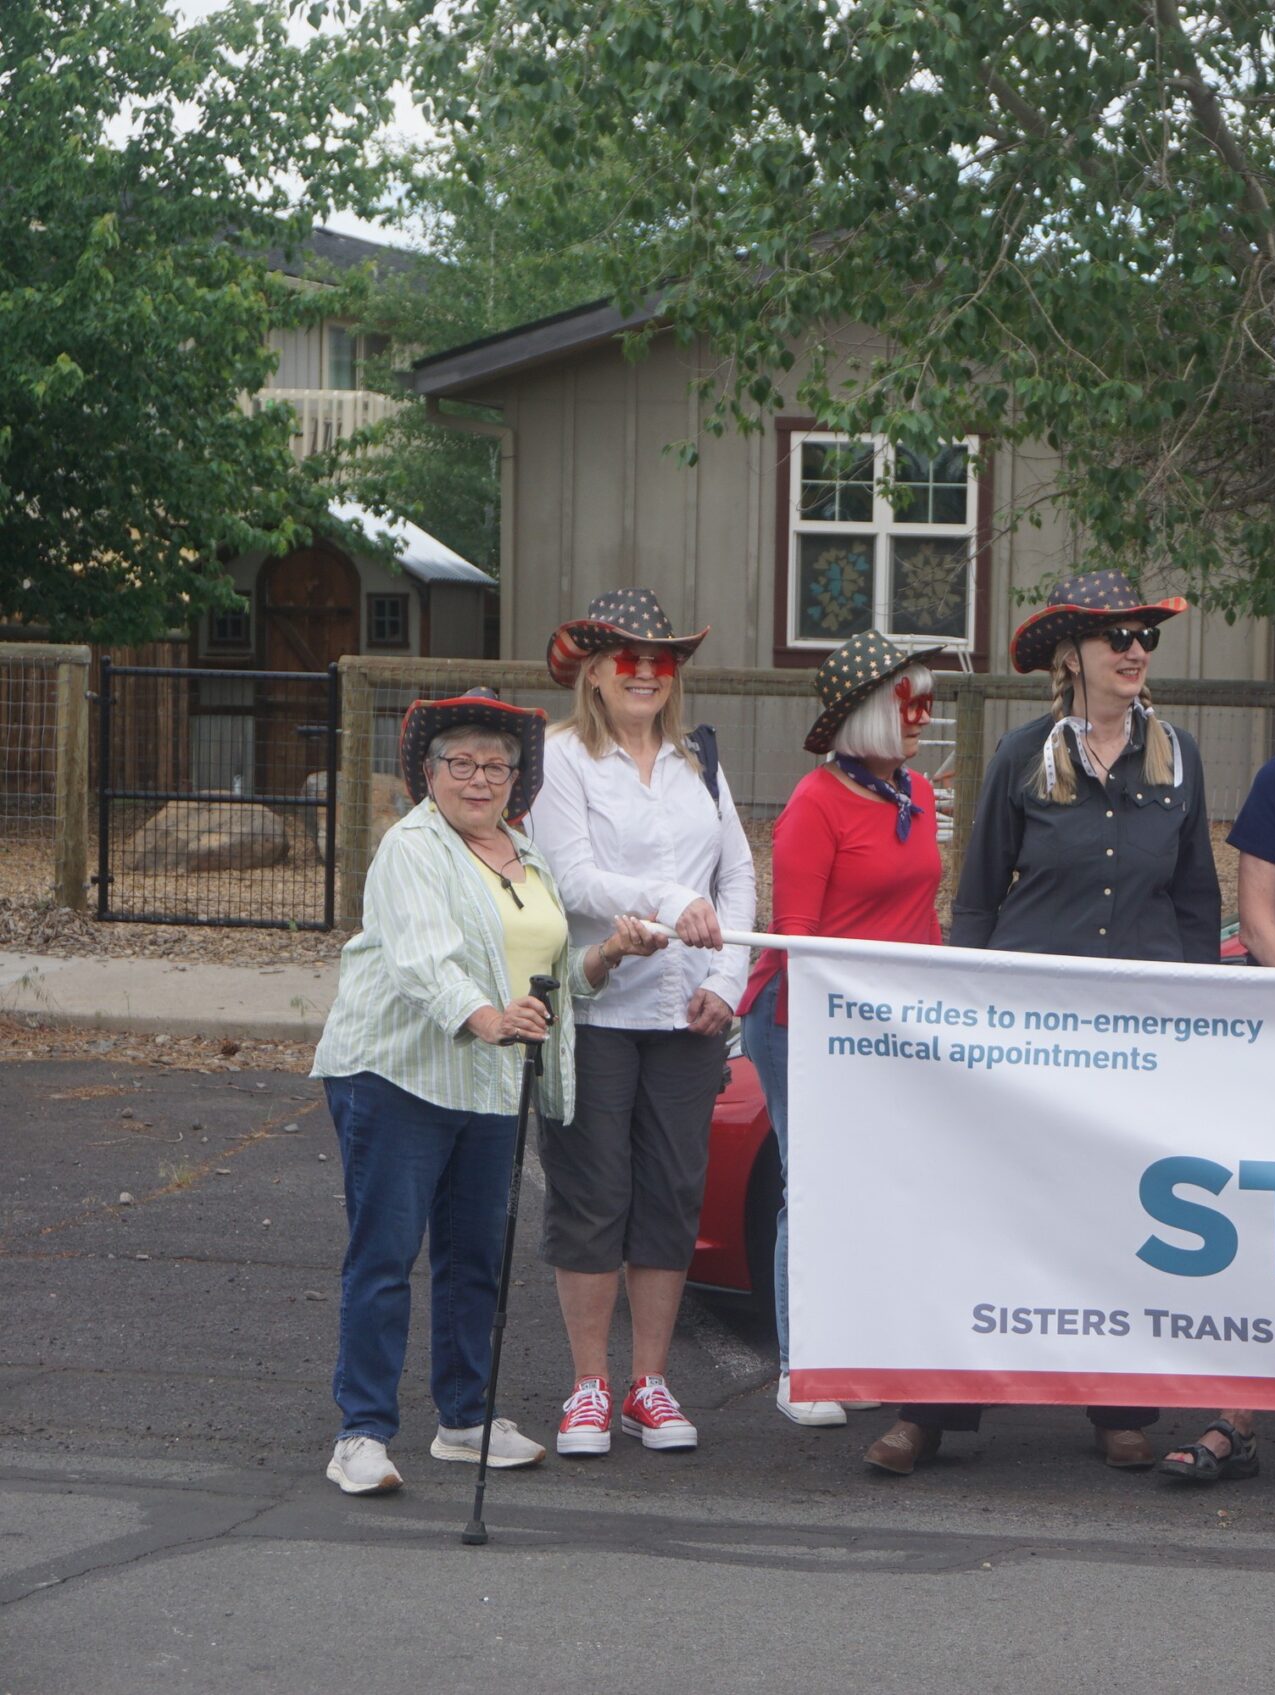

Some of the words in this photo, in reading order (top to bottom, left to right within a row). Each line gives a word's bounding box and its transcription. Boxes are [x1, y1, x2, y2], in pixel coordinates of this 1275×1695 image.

[828, 993, 892, 1022] Free
[900, 1000, 978, 1028] rides
[987, 1004, 1015, 1029] to
[1024, 1006, 1264, 1043] non-emergency
[828, 1032, 941, 1062] medical
[949, 1037, 1158, 1070] appointments
[971, 1303, 1131, 1337] SISTERS
